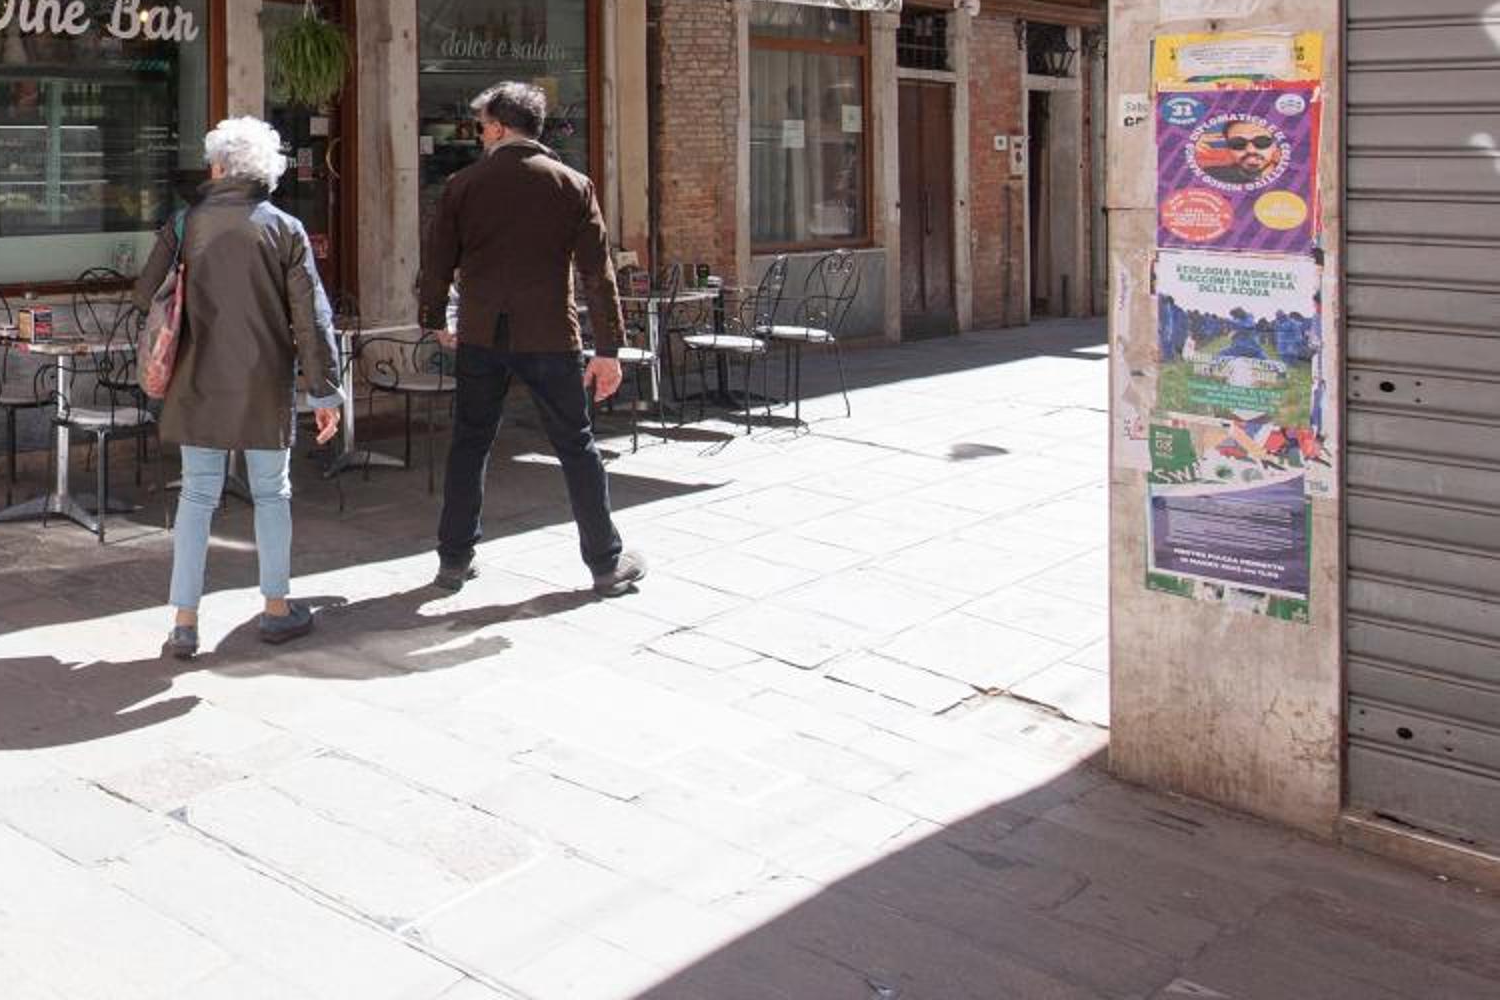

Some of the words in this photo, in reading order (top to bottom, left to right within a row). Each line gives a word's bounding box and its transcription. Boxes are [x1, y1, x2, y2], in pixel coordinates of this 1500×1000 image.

[441, 29, 494, 58] dolce
[1176, 264, 1231, 277] ECOLOGIA
[1179, 273, 1236, 286] RACCONTI
[1237, 277, 1251, 288] IN
[1252, 278, 1296, 291] DIFESA
